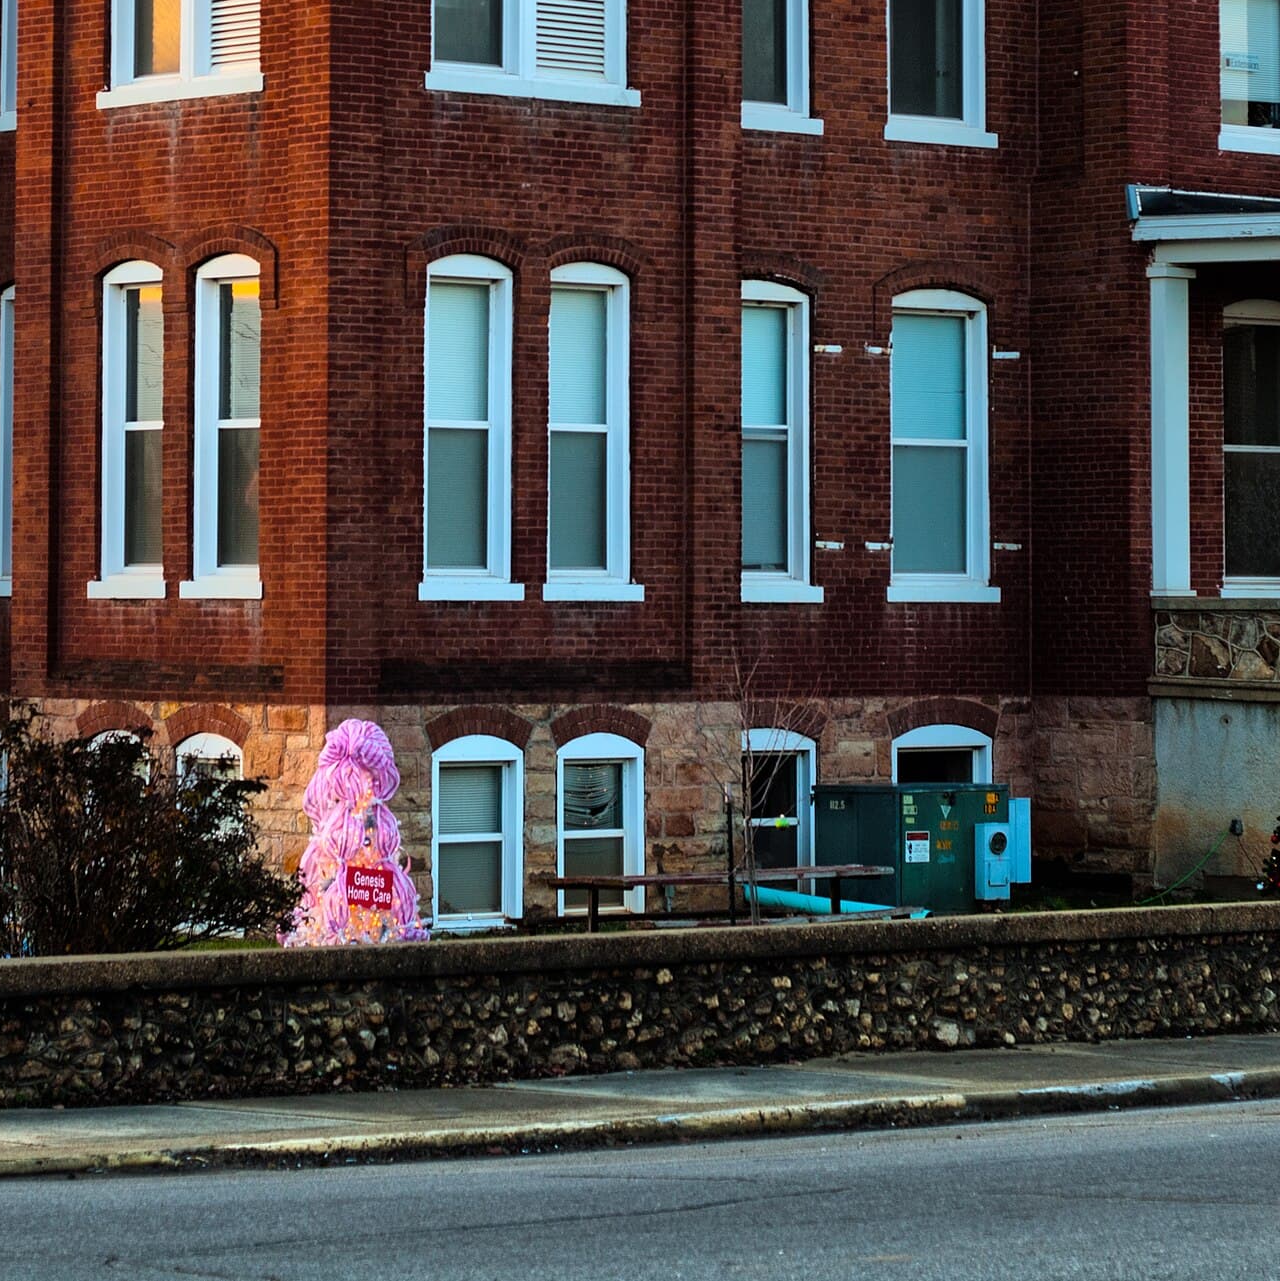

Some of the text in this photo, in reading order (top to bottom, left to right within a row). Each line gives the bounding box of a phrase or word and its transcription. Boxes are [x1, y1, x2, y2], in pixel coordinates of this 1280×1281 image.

[354, 871, 385, 888] Genesis
[348, 885, 391, 904] Home Care
